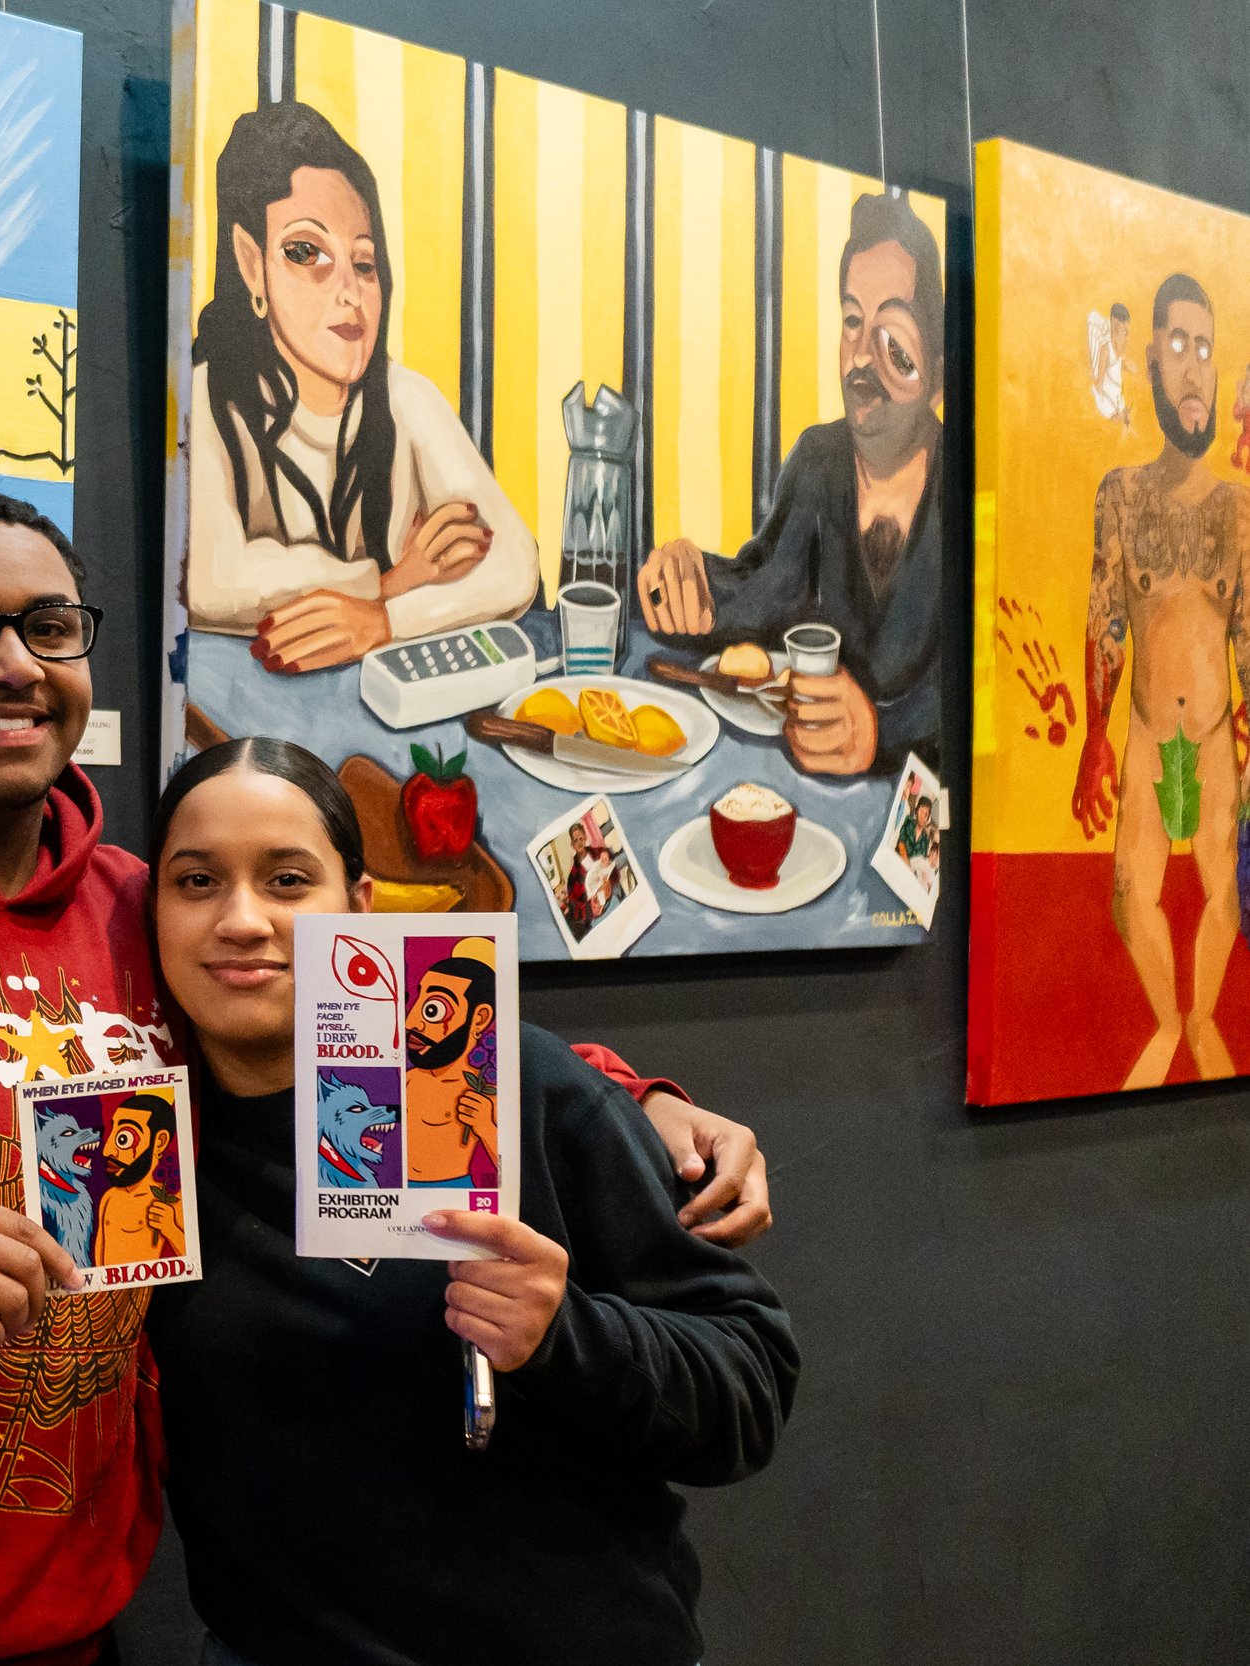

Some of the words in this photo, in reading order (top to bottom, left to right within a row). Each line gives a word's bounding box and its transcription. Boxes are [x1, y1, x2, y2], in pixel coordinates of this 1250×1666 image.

[317, 1003, 342, 1011] WHEN
[343, 1003, 360, 1011] EYE
[317, 1013, 344, 1021] FACED
[317, 1033, 321, 1042] I
[323, 1033, 357, 1043] DREW
[317, 1044, 384, 1059] BLOOD.
[23, 1085, 59, 1099] WHEN
[61, 1082, 84, 1095] EYE
[87, 1078, 126, 1091] FACED
[318, 1194, 399, 1206] EXHIBITION
[476, 1197, 492, 1207] 20
[318, 1207, 392, 1219] PROGRAM
[105, 1259, 192, 1285] BLOOD.
